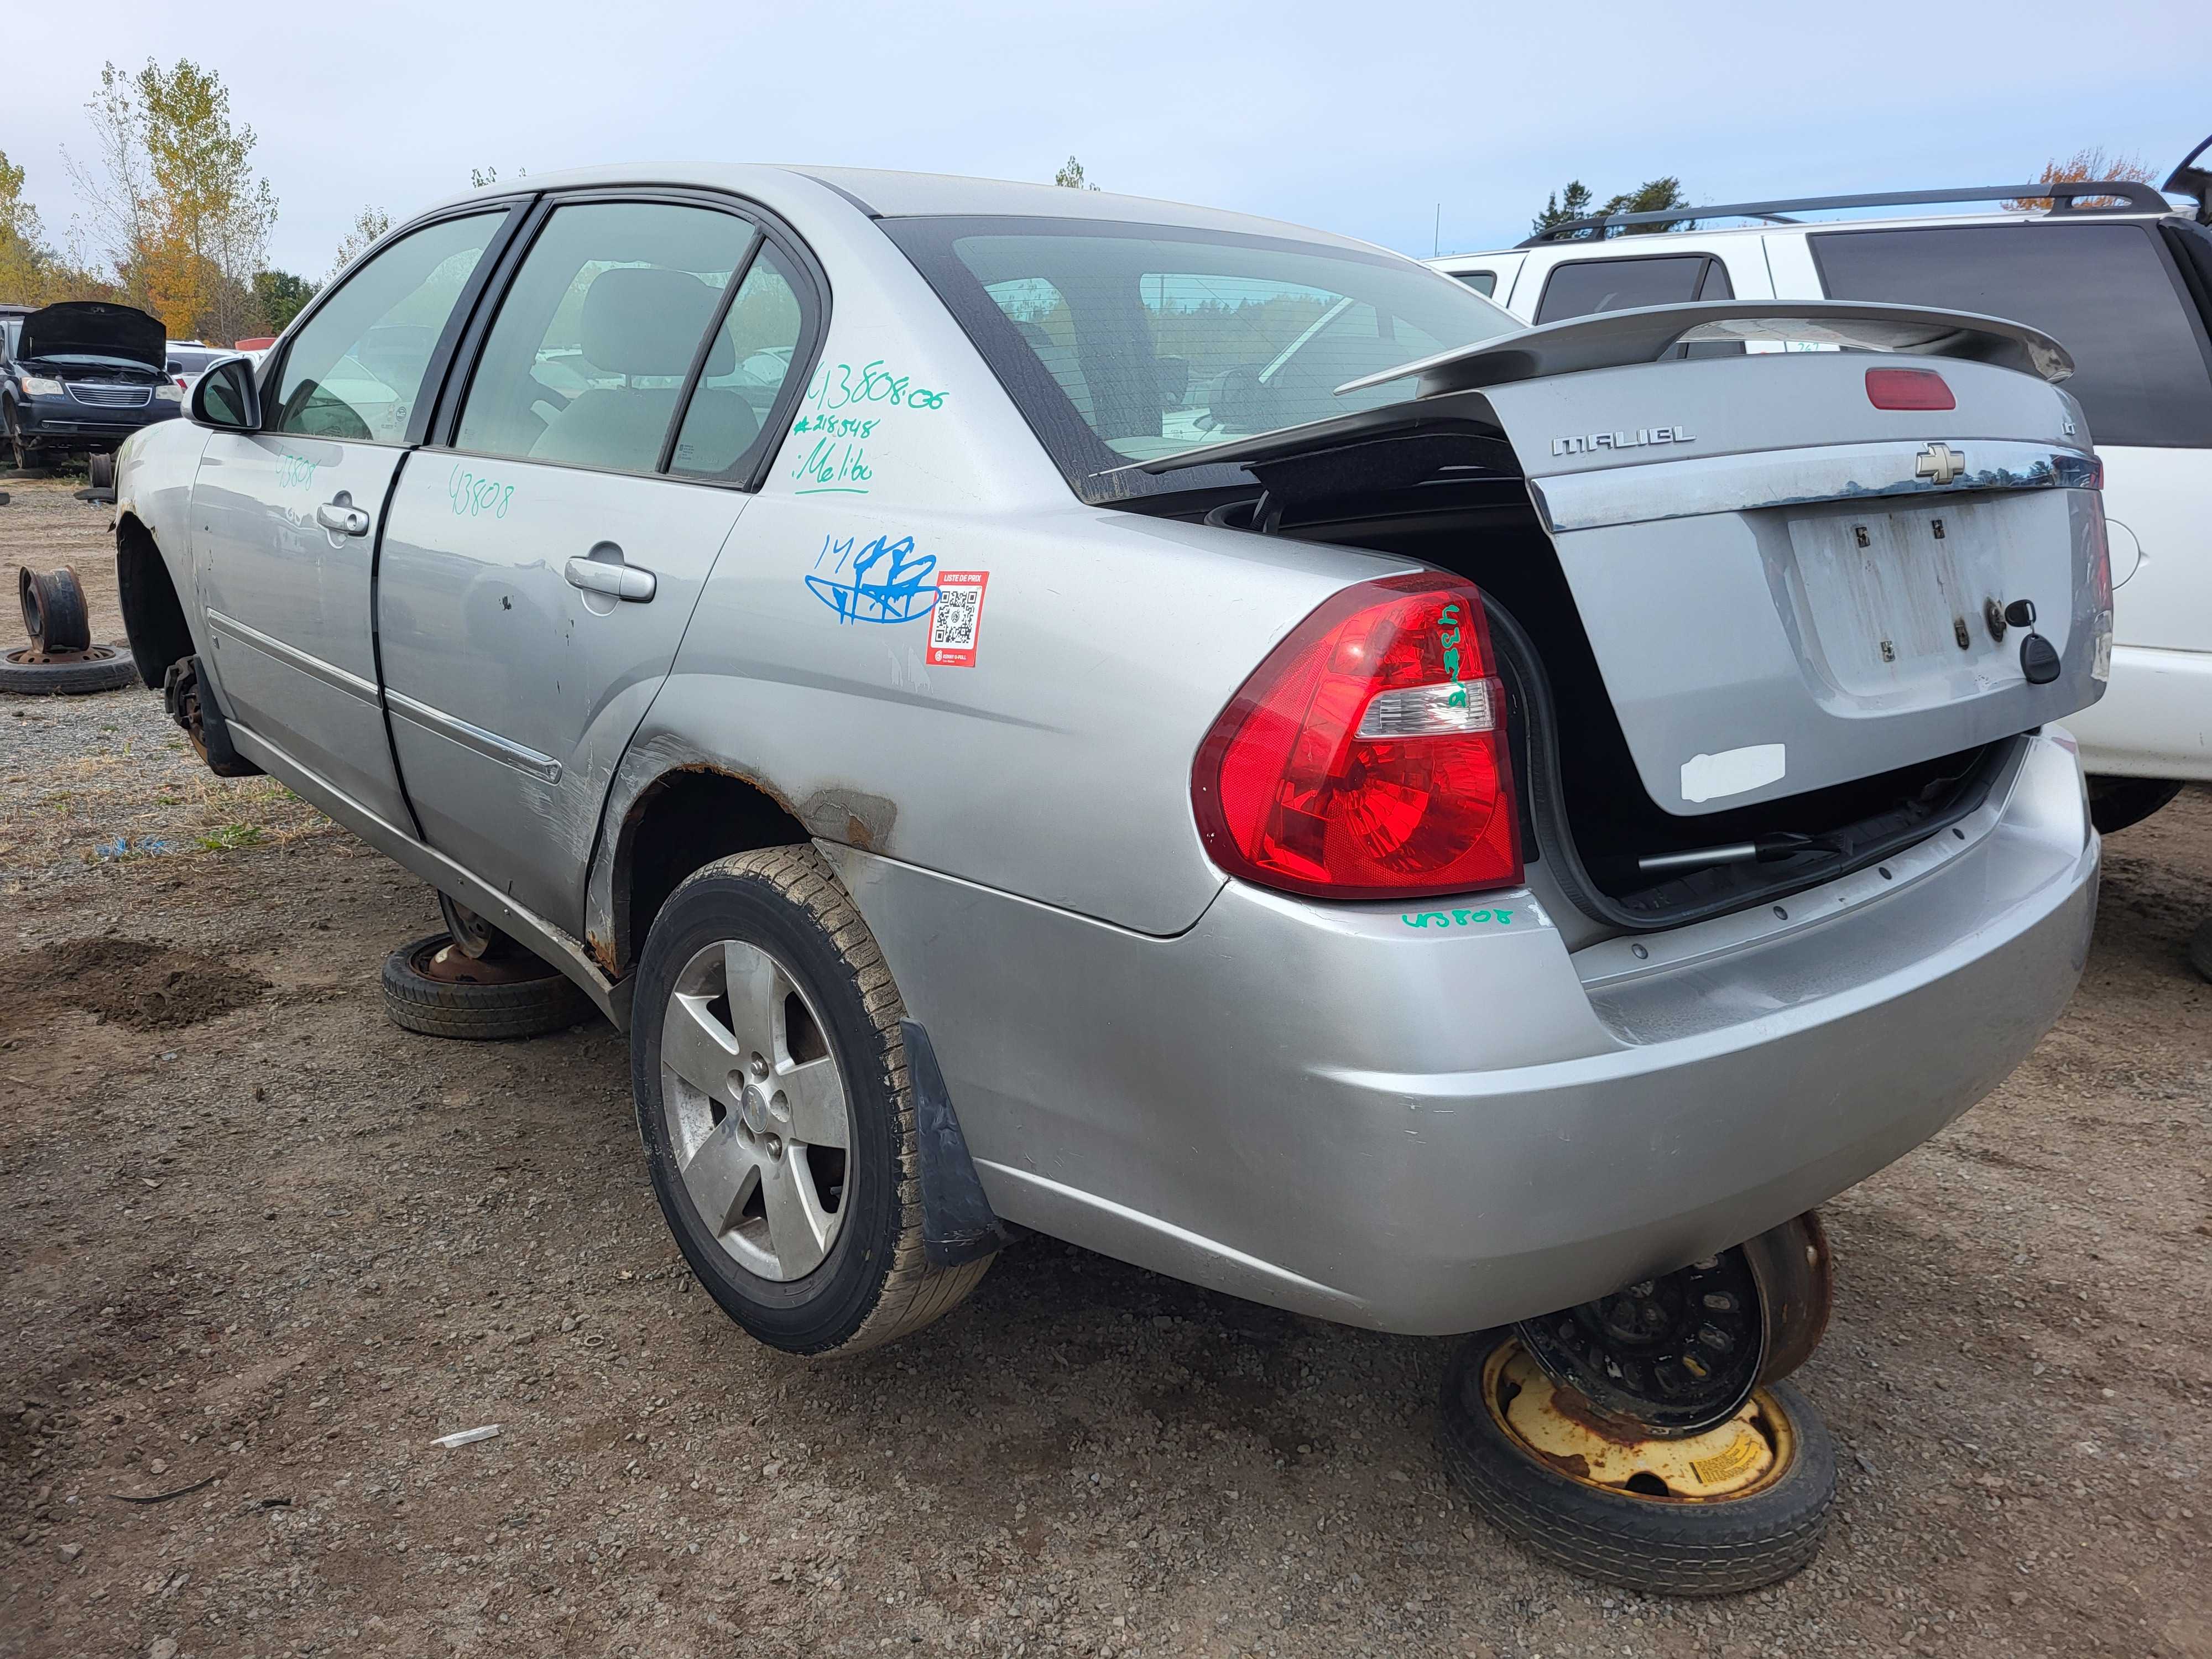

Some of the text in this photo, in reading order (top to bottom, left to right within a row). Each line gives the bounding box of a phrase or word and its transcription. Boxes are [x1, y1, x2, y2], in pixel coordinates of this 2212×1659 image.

[276, 445, 322, 491] 43808
[449, 463, 514, 519] 43808
[967, 574, 982, 582] PRIX
[1402, 909, 1514, 927] 43808
